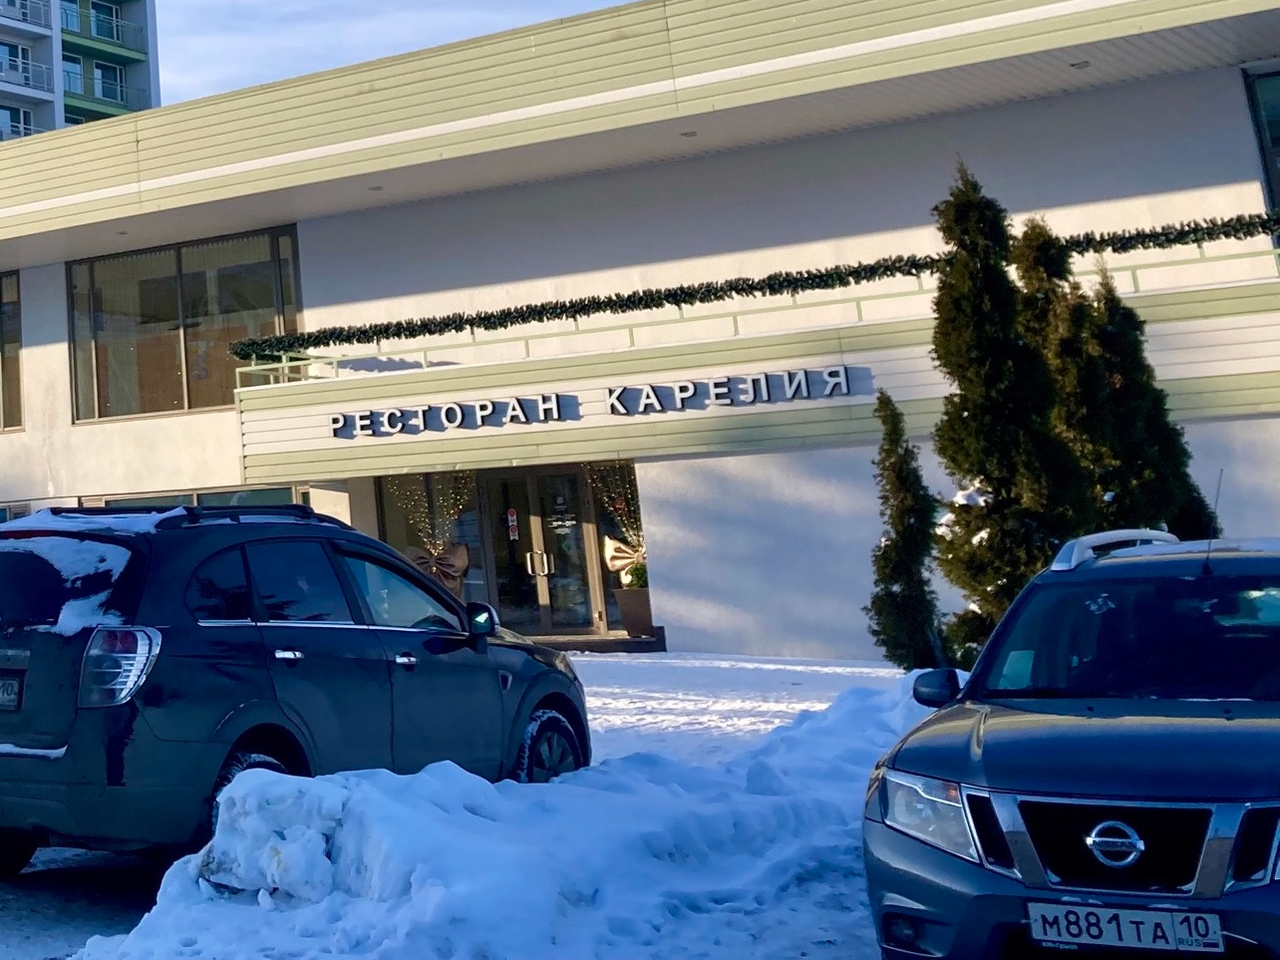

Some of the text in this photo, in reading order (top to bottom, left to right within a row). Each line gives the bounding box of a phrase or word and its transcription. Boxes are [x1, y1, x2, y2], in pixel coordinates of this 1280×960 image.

[328, 365, 850, 438] РЕСТОРАН КАРЕЛИЯ
[1040, 909, 1210, 945] М881ТА 10
[1177, 937, 1203, 948] RUS
